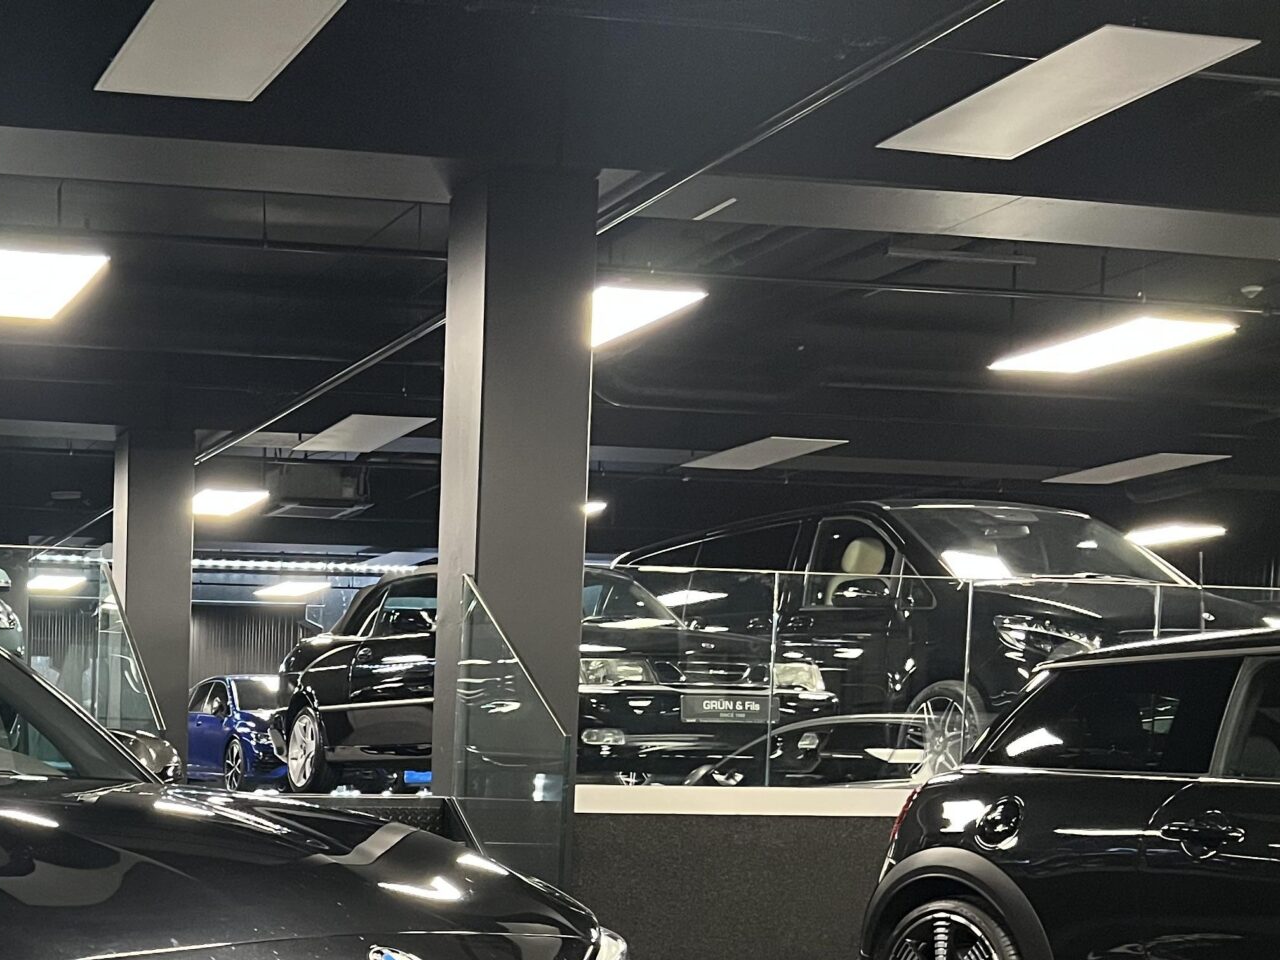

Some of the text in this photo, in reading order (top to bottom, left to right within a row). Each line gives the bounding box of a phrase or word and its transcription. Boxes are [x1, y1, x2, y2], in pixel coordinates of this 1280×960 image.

[703, 699, 760, 711] GRÜN & Fils
